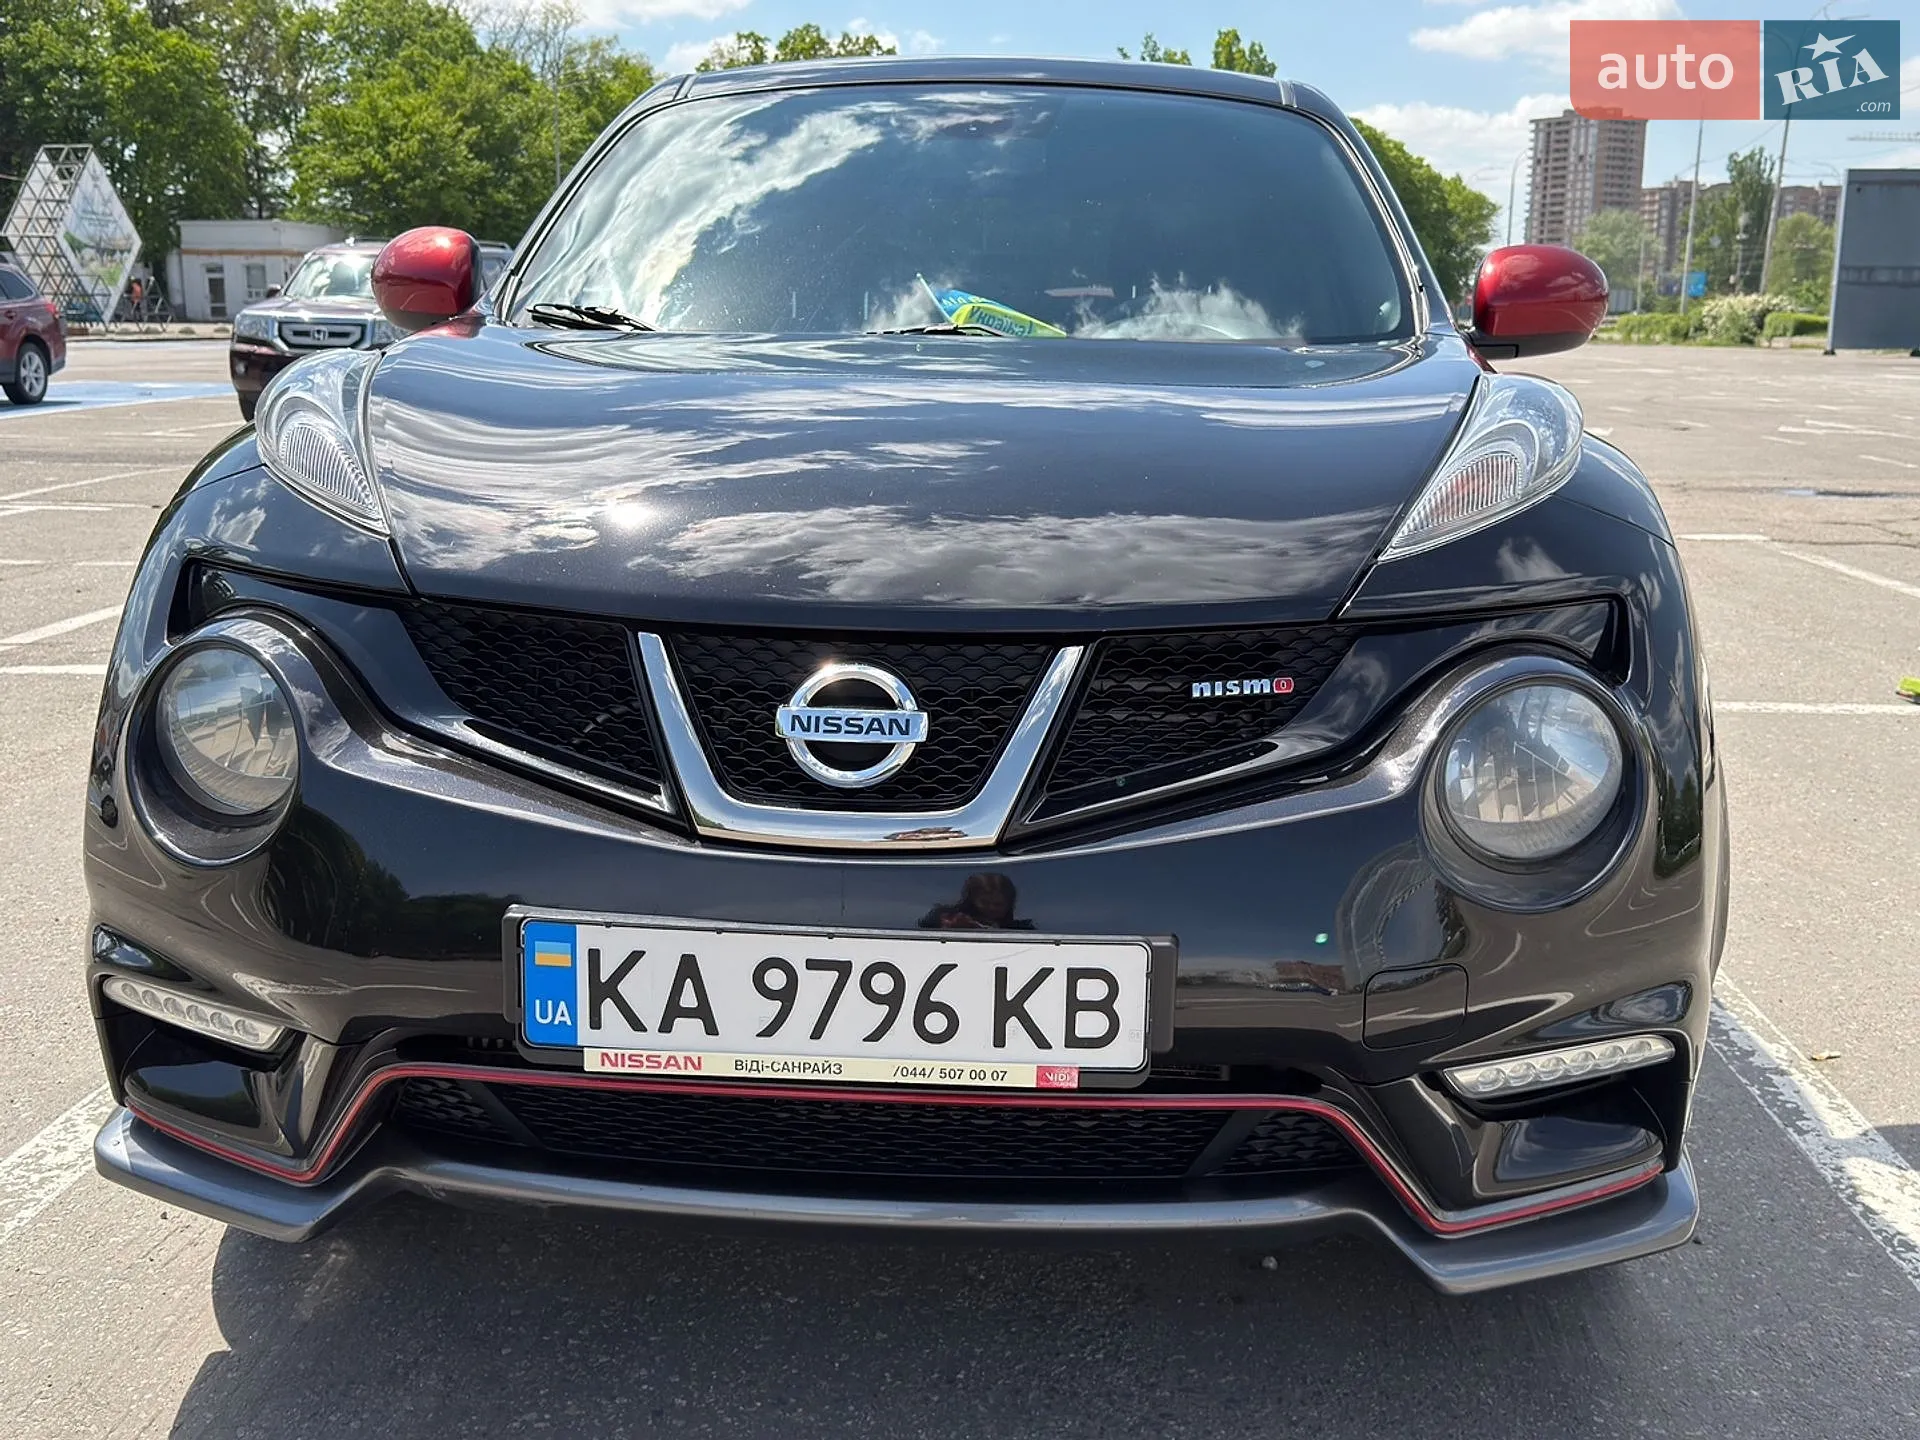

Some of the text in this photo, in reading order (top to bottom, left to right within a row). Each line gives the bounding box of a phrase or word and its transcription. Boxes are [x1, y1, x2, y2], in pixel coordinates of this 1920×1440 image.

[790, 714, 911, 736] NISSAN
[587, 948, 1121, 1049] KA 9796 KB
[534, 998, 572, 1026] UA
[599, 1052, 703, 1071] NISSAN
[893, 1066, 1008, 1082] /044/ 507 00 07
